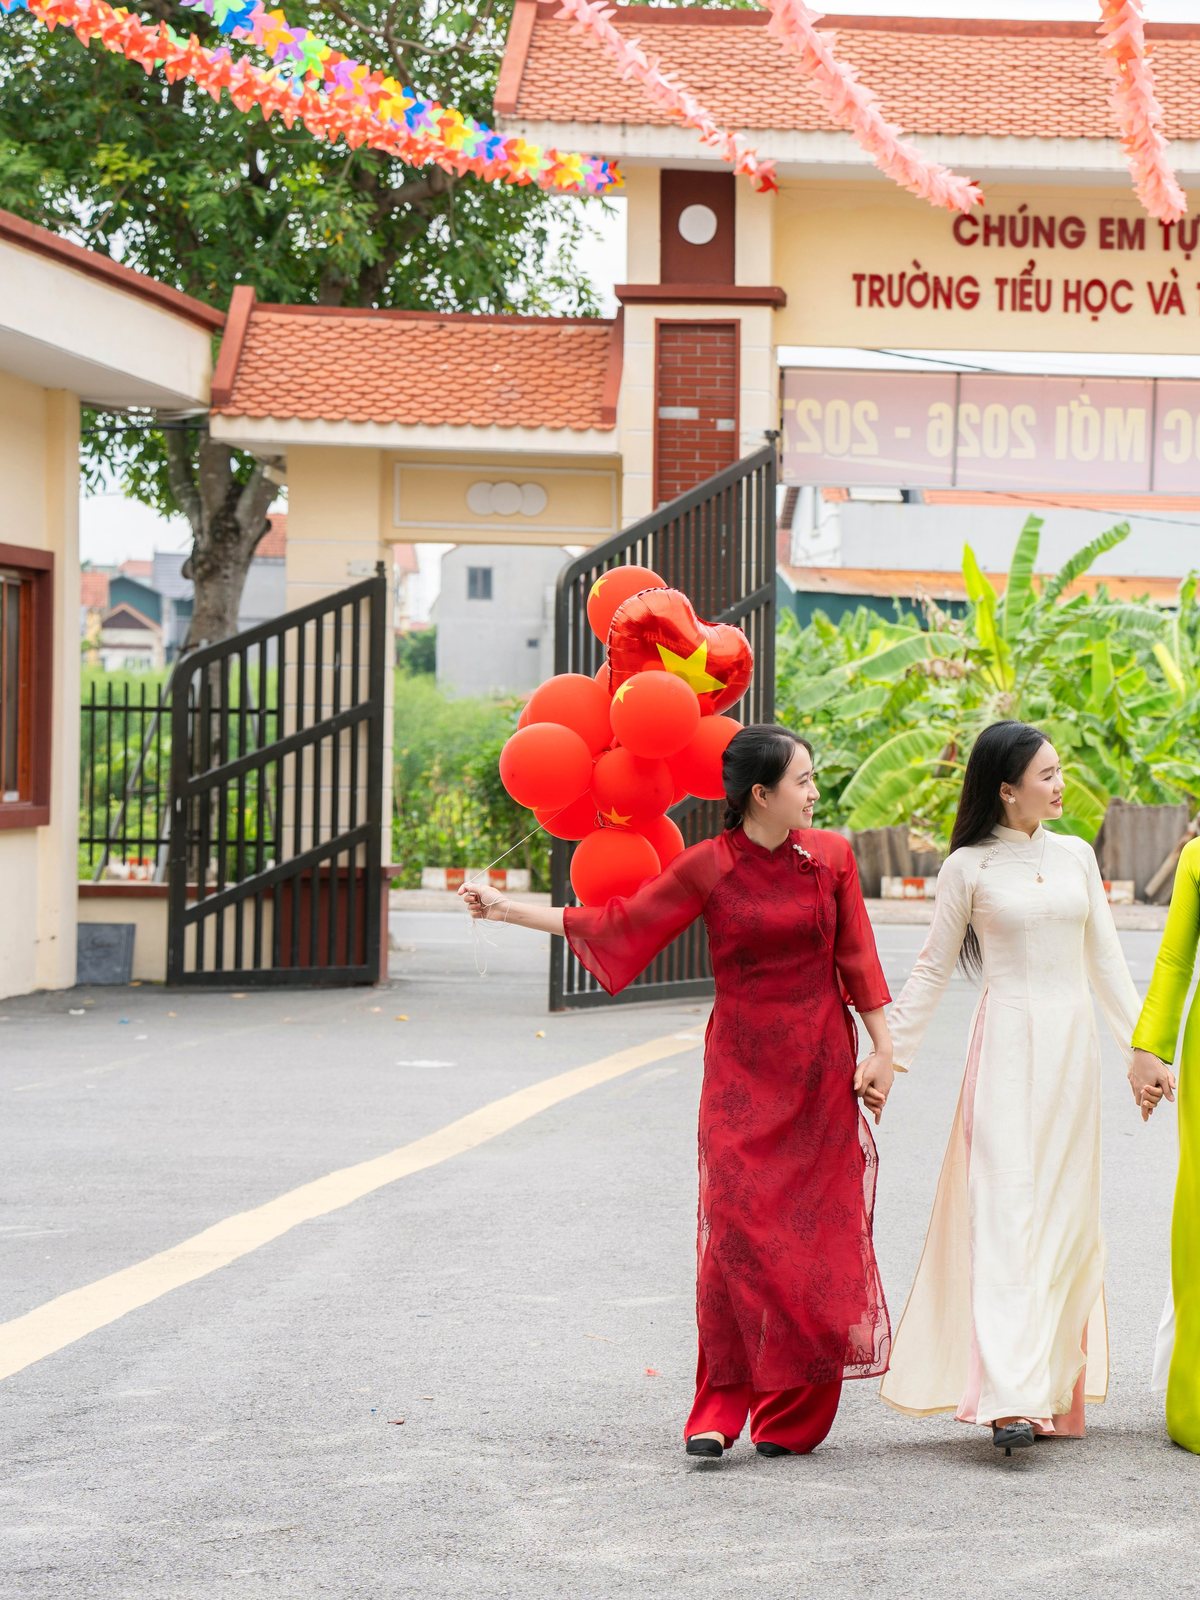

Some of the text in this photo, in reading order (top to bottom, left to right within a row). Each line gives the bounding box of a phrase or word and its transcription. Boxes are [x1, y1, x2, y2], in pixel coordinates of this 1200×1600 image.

[952, 203, 1086, 249] CHÚNG
[1099, 217, 1145, 251] EM
[852, 259, 980, 310] TRƯỜNG
[994, 259, 1052, 313] TIỂU
[1063, 279, 1134, 322] HỌC
[1146, 267, 1186, 315] VÀ
